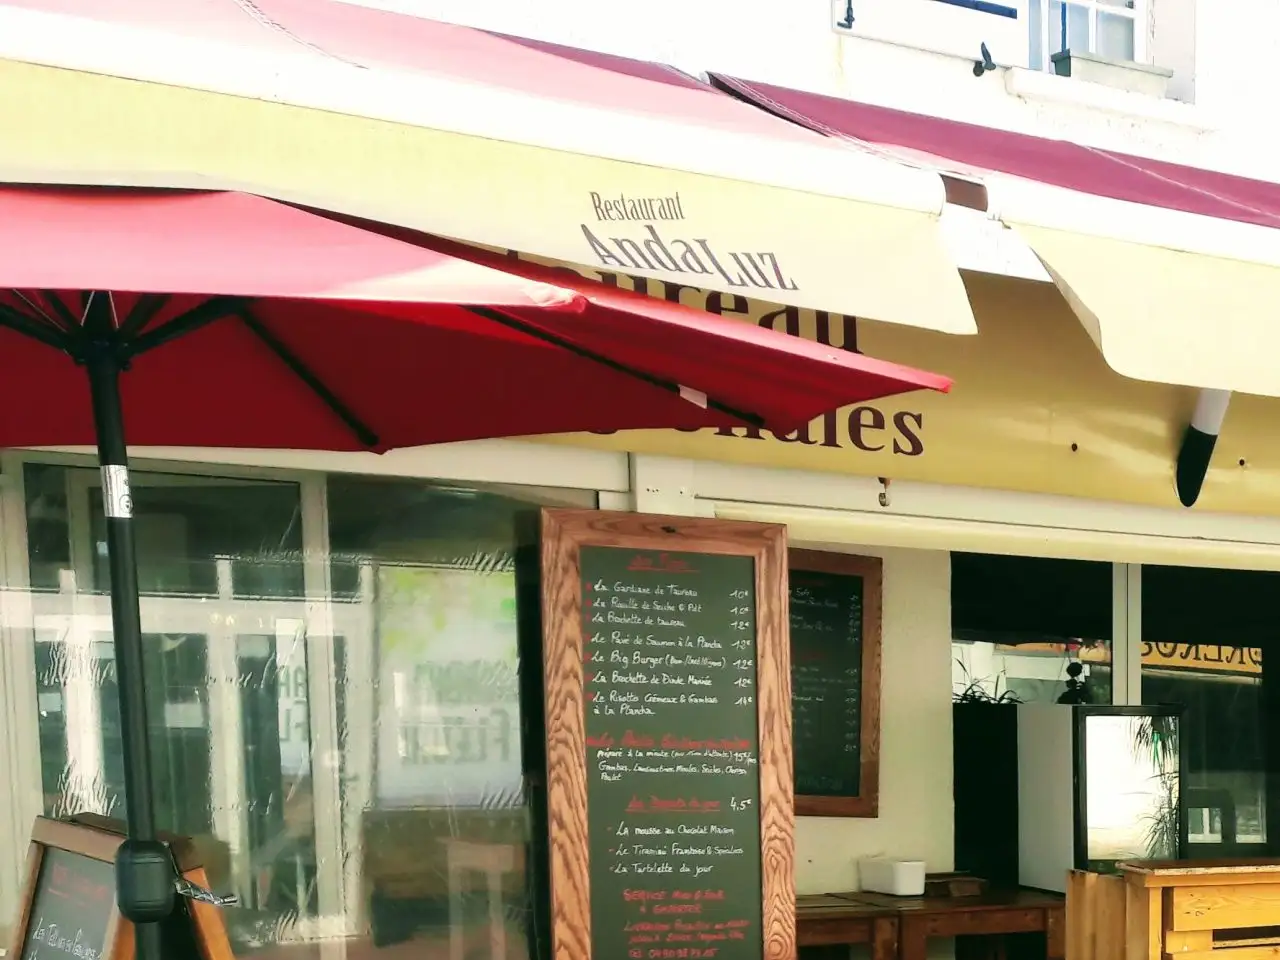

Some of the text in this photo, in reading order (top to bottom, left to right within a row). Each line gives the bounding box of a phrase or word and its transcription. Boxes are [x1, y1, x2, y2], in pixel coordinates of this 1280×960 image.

[589, 191, 685, 222] Restaurant
[610, 650, 629, 669] Big
[632, 651, 662, 668] Burger
[632, 863, 673, 873] Tartelette
[680, 863, 691, 873] du
[694, 866, 713, 877] jour
